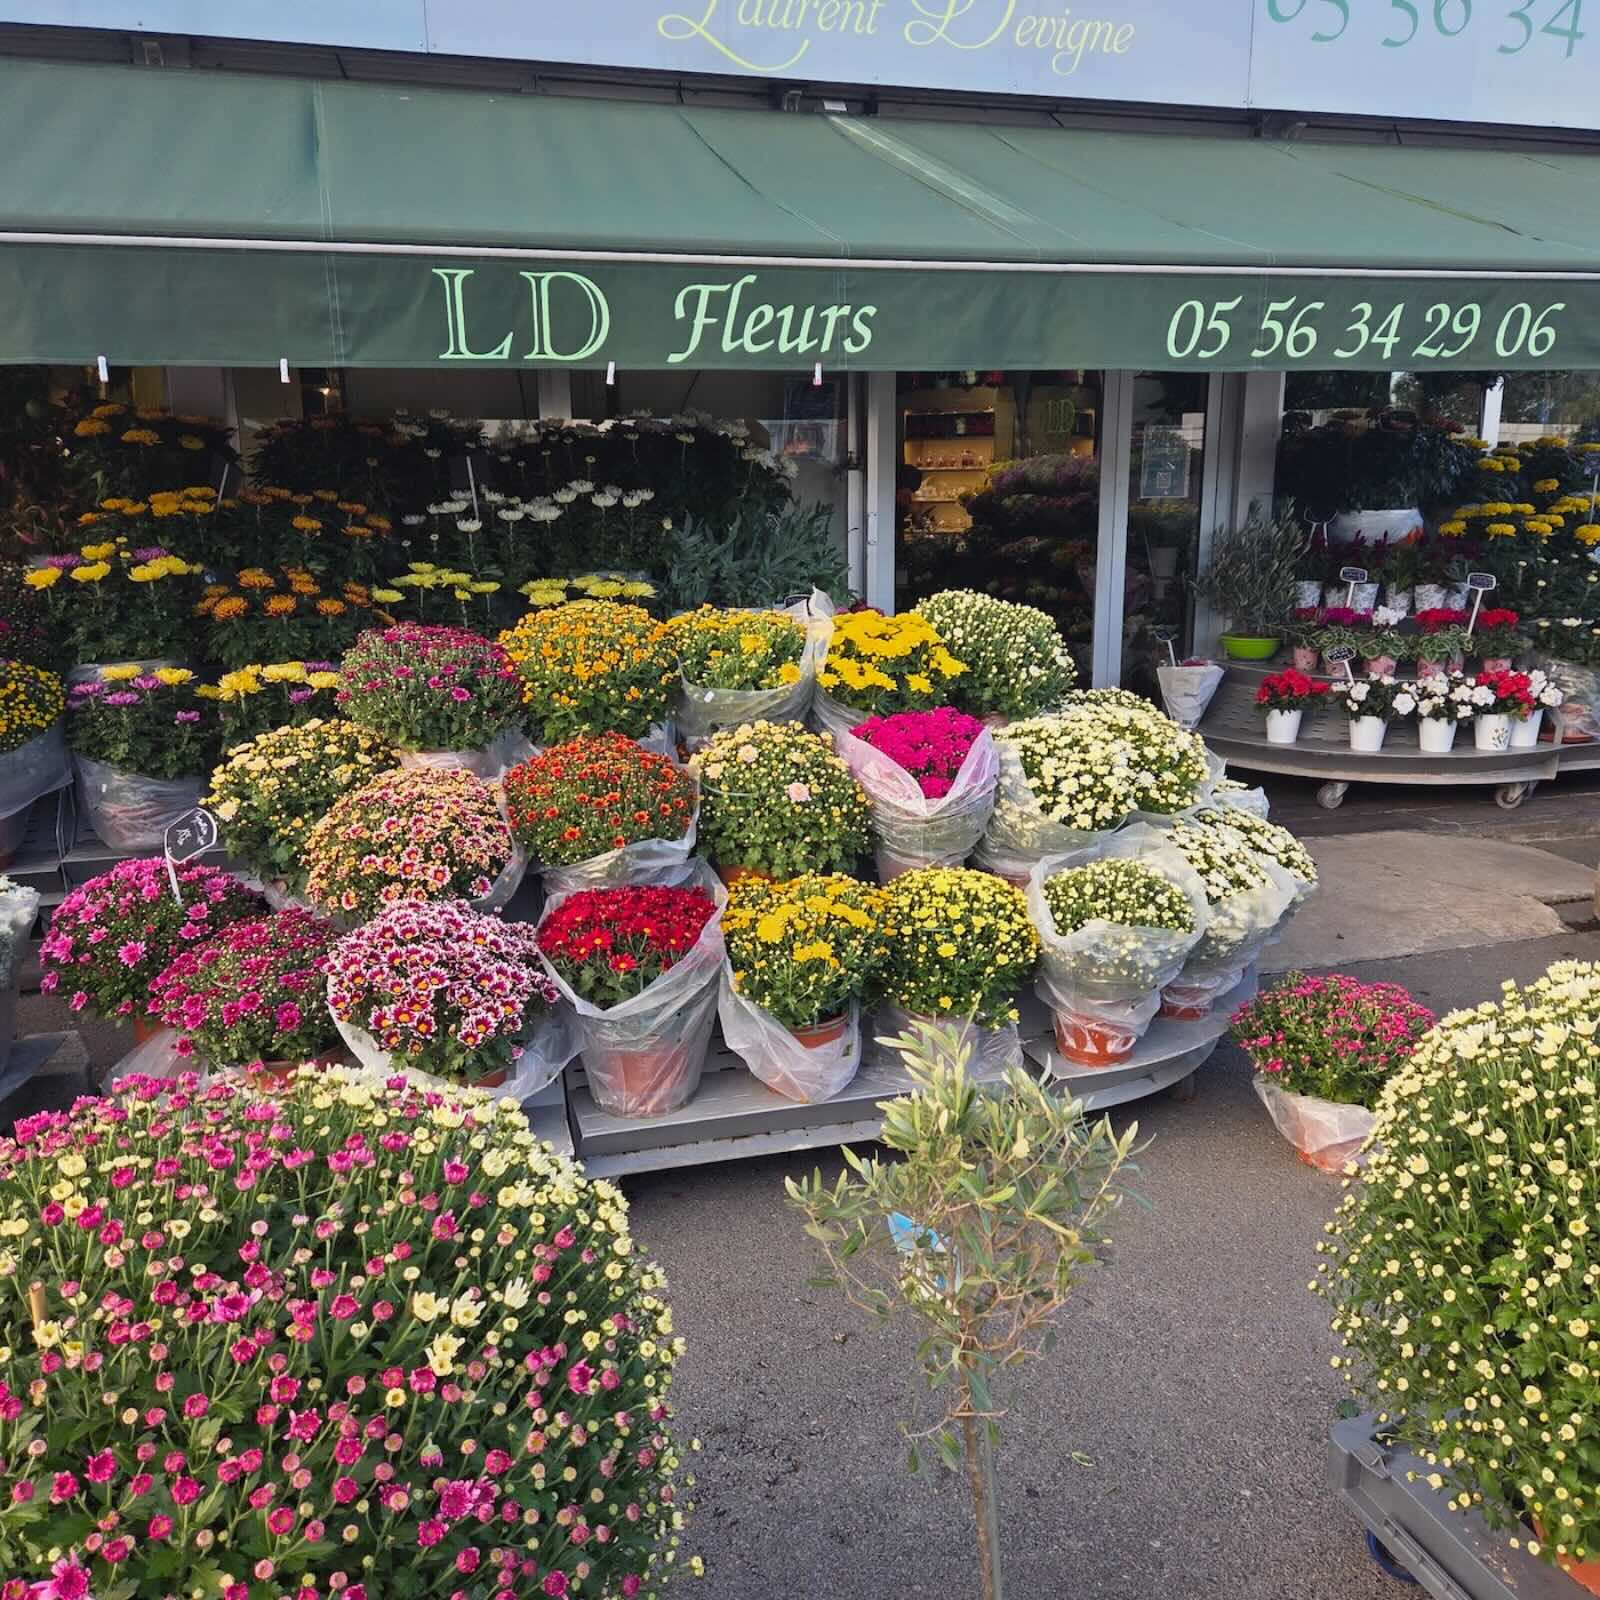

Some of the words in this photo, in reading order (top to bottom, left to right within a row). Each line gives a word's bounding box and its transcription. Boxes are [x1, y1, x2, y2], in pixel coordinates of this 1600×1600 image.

[657, 0, 883, 72] Laurent
[903, 0, 1136, 76] Devigne
[1496, 0, 1585, 58] 34
[431, 268, 610, 361] LD
[666, 274, 878, 363] Fleurs
[1167, 295, 1243, 358] 05
[1251, 295, 1325, 358] 56
[1334, 302, 1405, 360] 34
[1412, 303, 1482, 358] 29
[1495, 302, 1566, 358] 06
